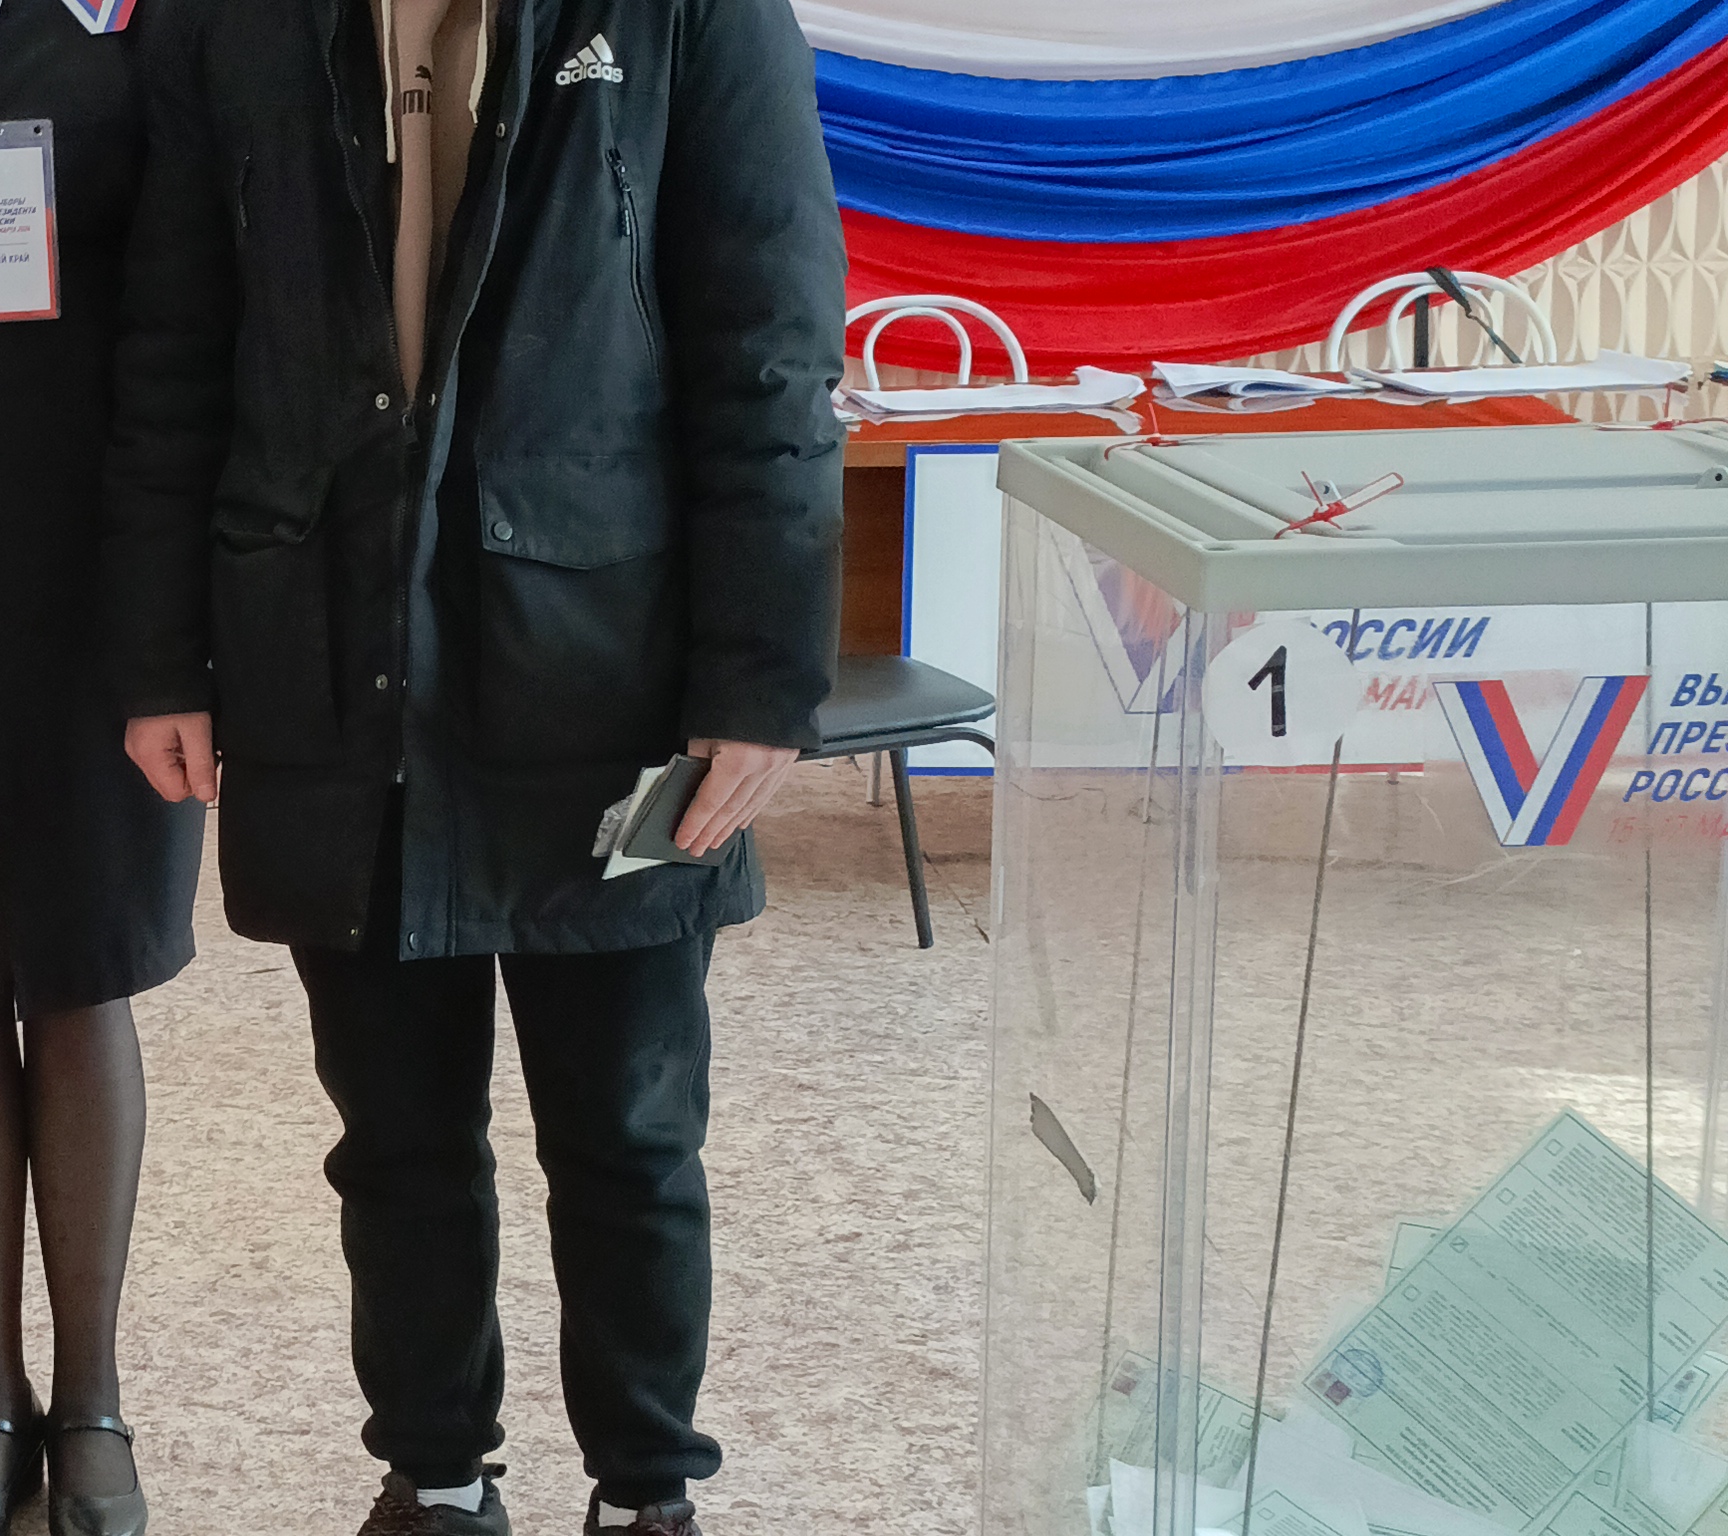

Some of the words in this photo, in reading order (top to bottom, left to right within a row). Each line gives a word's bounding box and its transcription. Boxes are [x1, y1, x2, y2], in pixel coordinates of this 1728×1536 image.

[555, 61, 624, 86] adidas
[8, 252, 30, 263] КРАЙ
[1247, 645, 1288, 738] 1
